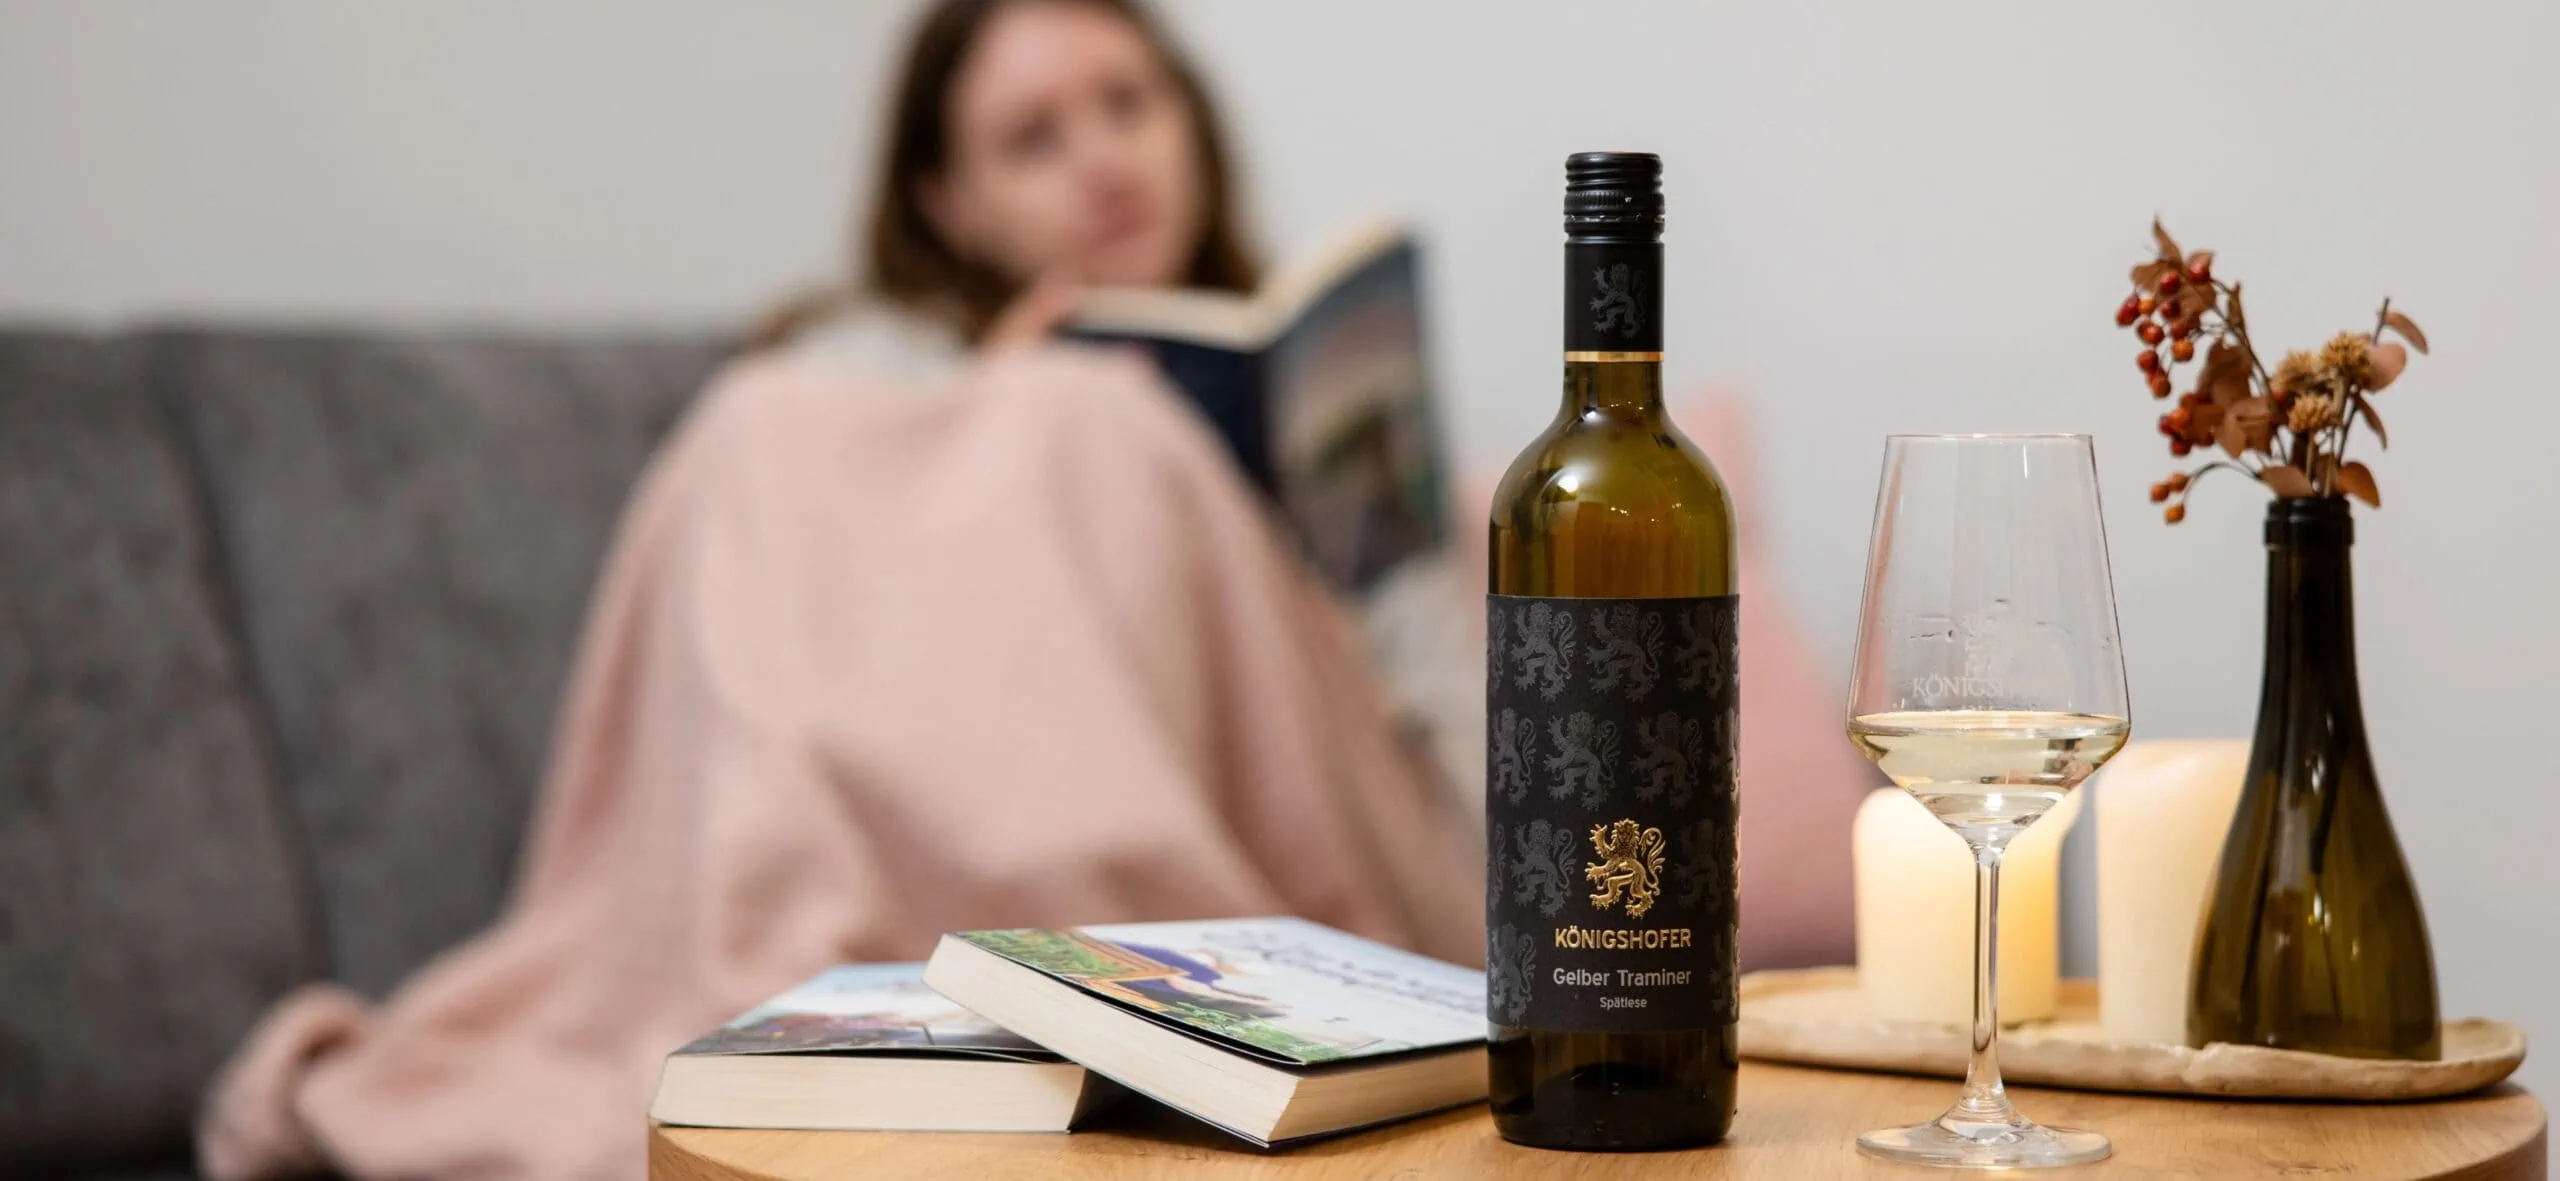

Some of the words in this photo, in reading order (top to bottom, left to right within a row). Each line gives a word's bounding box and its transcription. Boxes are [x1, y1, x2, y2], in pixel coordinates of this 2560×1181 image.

[1554, 925, 1692, 949] KÖNIGSHOFER
[1553, 967, 1609, 987] Gelber
[1617, 968, 1692, 987] Traminer
[1599, 996, 1648, 1011] Spätlese
